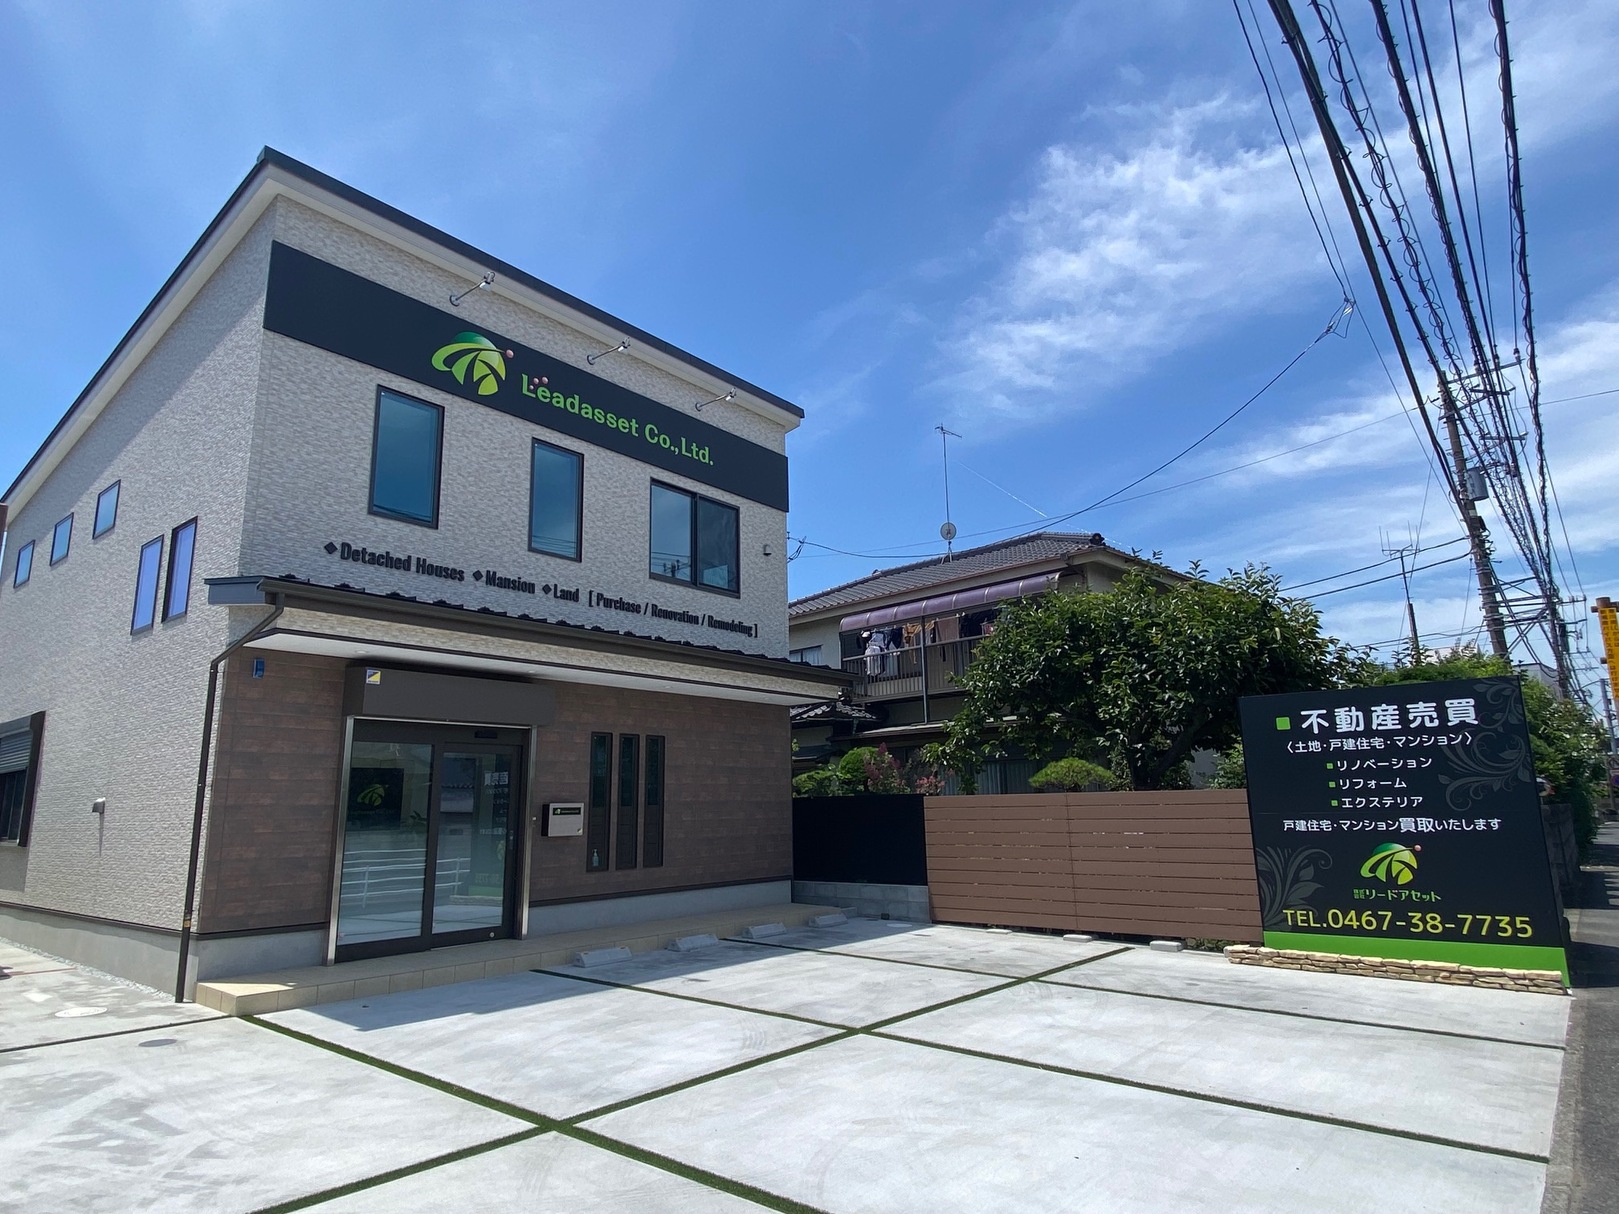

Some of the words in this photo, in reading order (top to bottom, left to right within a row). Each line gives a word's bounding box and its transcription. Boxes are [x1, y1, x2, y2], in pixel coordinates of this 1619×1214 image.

[521, 374, 639, 437] Leadasset
[340, 542, 412, 572] Detached
[416, 557, 465, 581] Houses
[486, 570, 536, 594] Mansion
[554, 584, 580, 602] Land
[597, 593, 641, 614] Purchase
[652, 604, 699, 625] Renovation
[1300, 698, 1479, 734] 不動産売買
[1337, 757, 1432, 771] リノベーション
[1339, 778, 1407, 790] リフォーム
[1341, 796, 1423, 808] エクステリア
[1283, 908, 1532, 938] TEL.0467-38-7735
